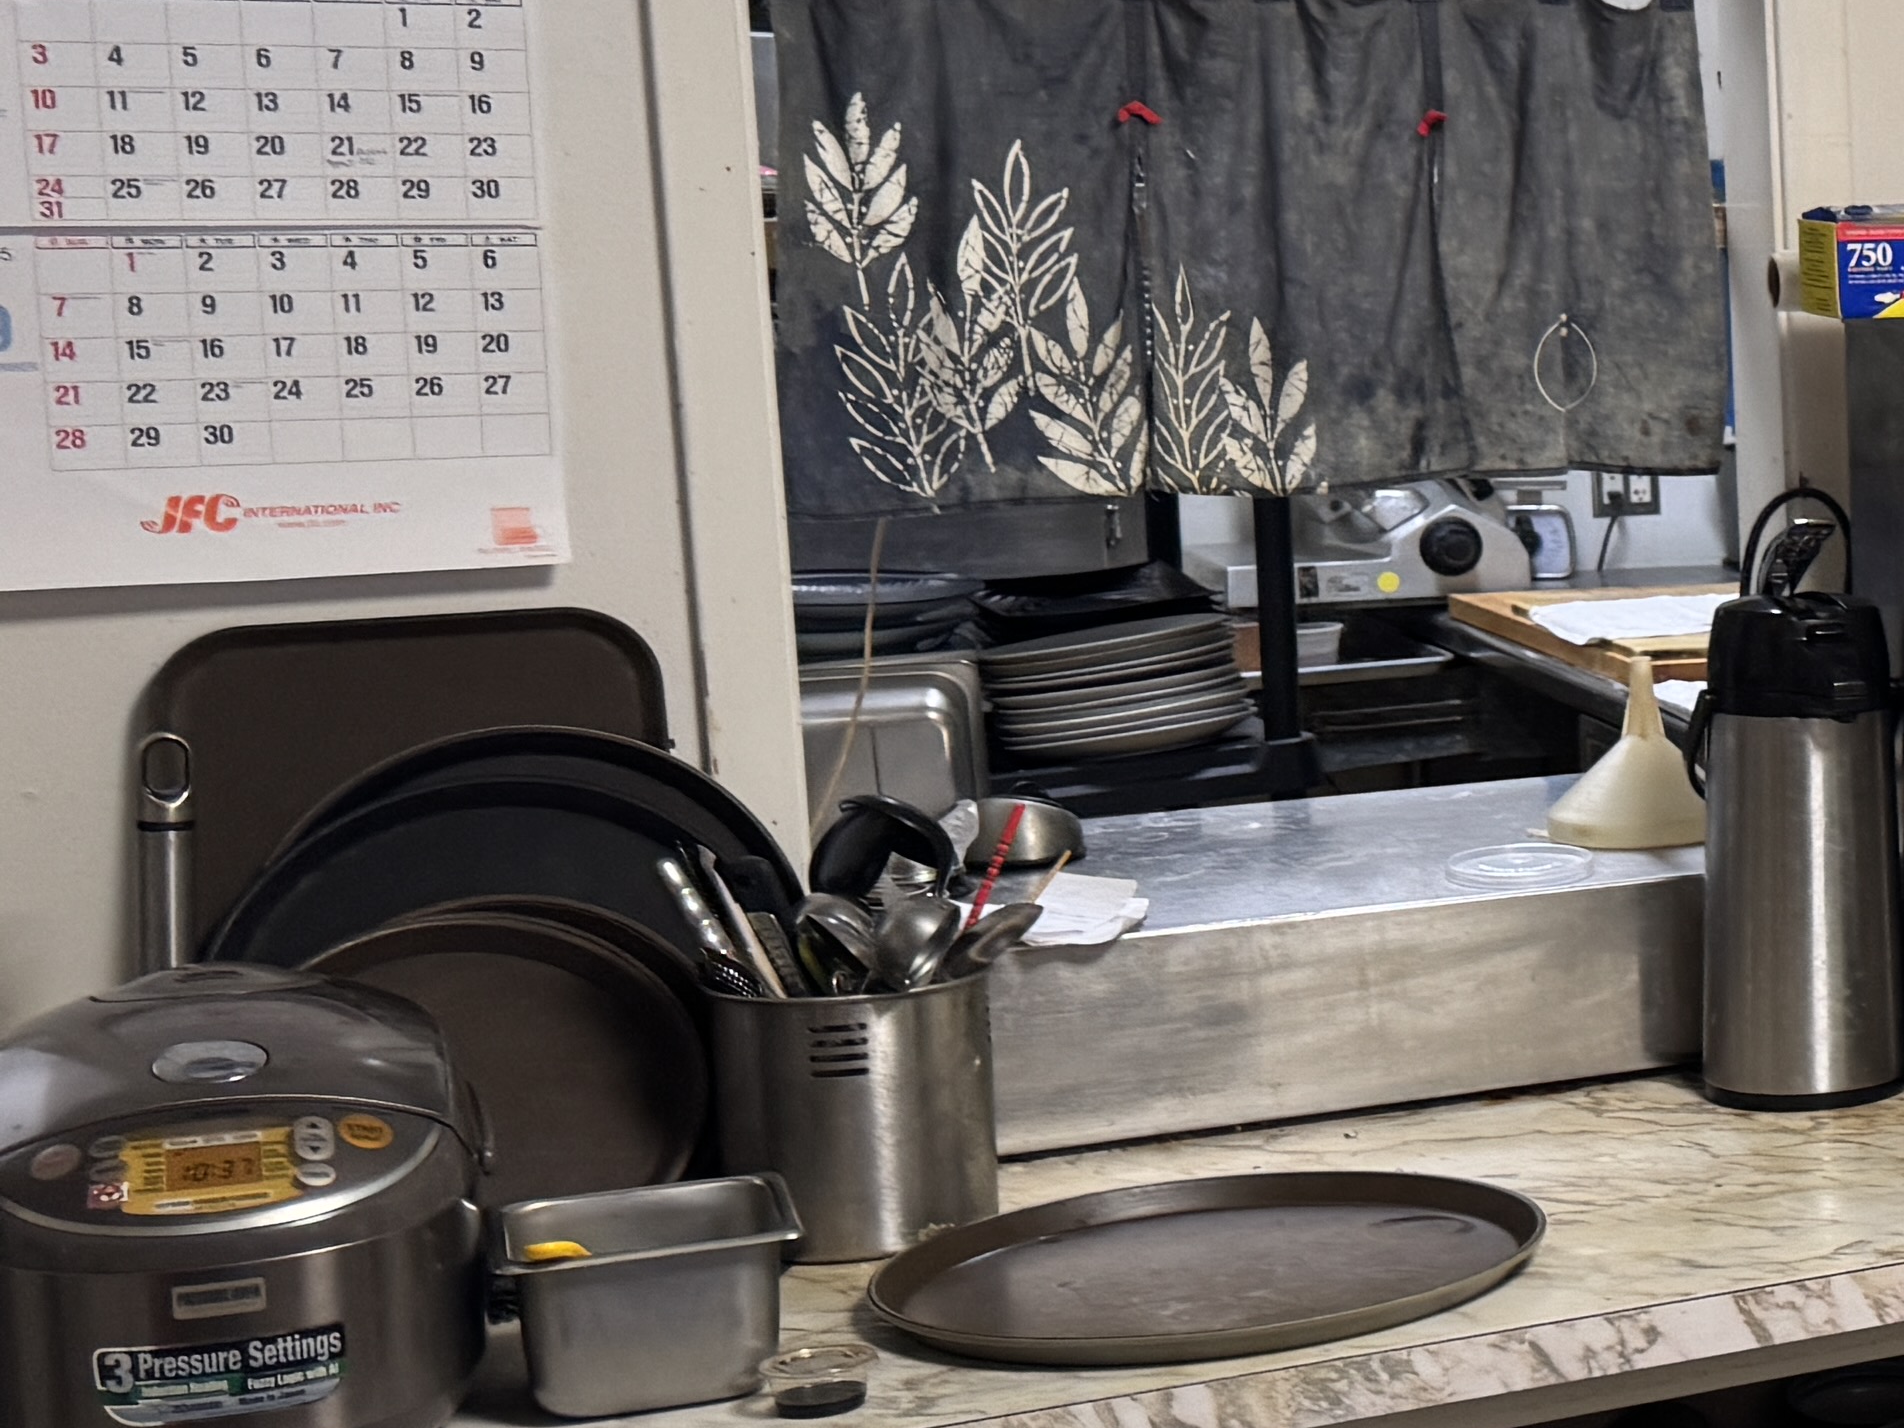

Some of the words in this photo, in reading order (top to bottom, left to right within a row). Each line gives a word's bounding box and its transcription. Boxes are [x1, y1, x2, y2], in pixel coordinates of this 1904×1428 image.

[398, 8, 408, 27] 1
[467, 8, 482, 29] 2
[31, 44, 48, 64] 3
[108, 45, 123, 66] 4
[182, 46, 198, 67] 5
[256, 48, 272, 68] 6
[328, 48, 343, 69] 7
[400, 50, 414, 70] 8
[470, 51, 484, 71] 9
[30, 89, 56, 109] 10
[106, 90, 128, 111] 11
[181, 91, 207, 111] 12
[254, 92, 279, 112] 13
[327, 92, 350, 113] 14
[398, 93, 422, 113] 15
[468, 94, 492, 114] 16
[33, 133, 60, 155] 17
[109, 134, 135, 155] 18
[184, 135, 210, 155] 19
[255, 135, 285, 155] 20
[330, 136, 354, 156] 21
[398, 136, 428, 157] 22
[469, 137, 497, 157] 23
[1846, 242, 1893, 267] 750
[140, 493, 241, 535] JFC
[243, 502, 369, 519] INTERNATIONAL
[103, 1351, 133, 1394] 3
[138, 1349, 242, 1379] Pressure
[248, 1331, 342, 1368] Settings
